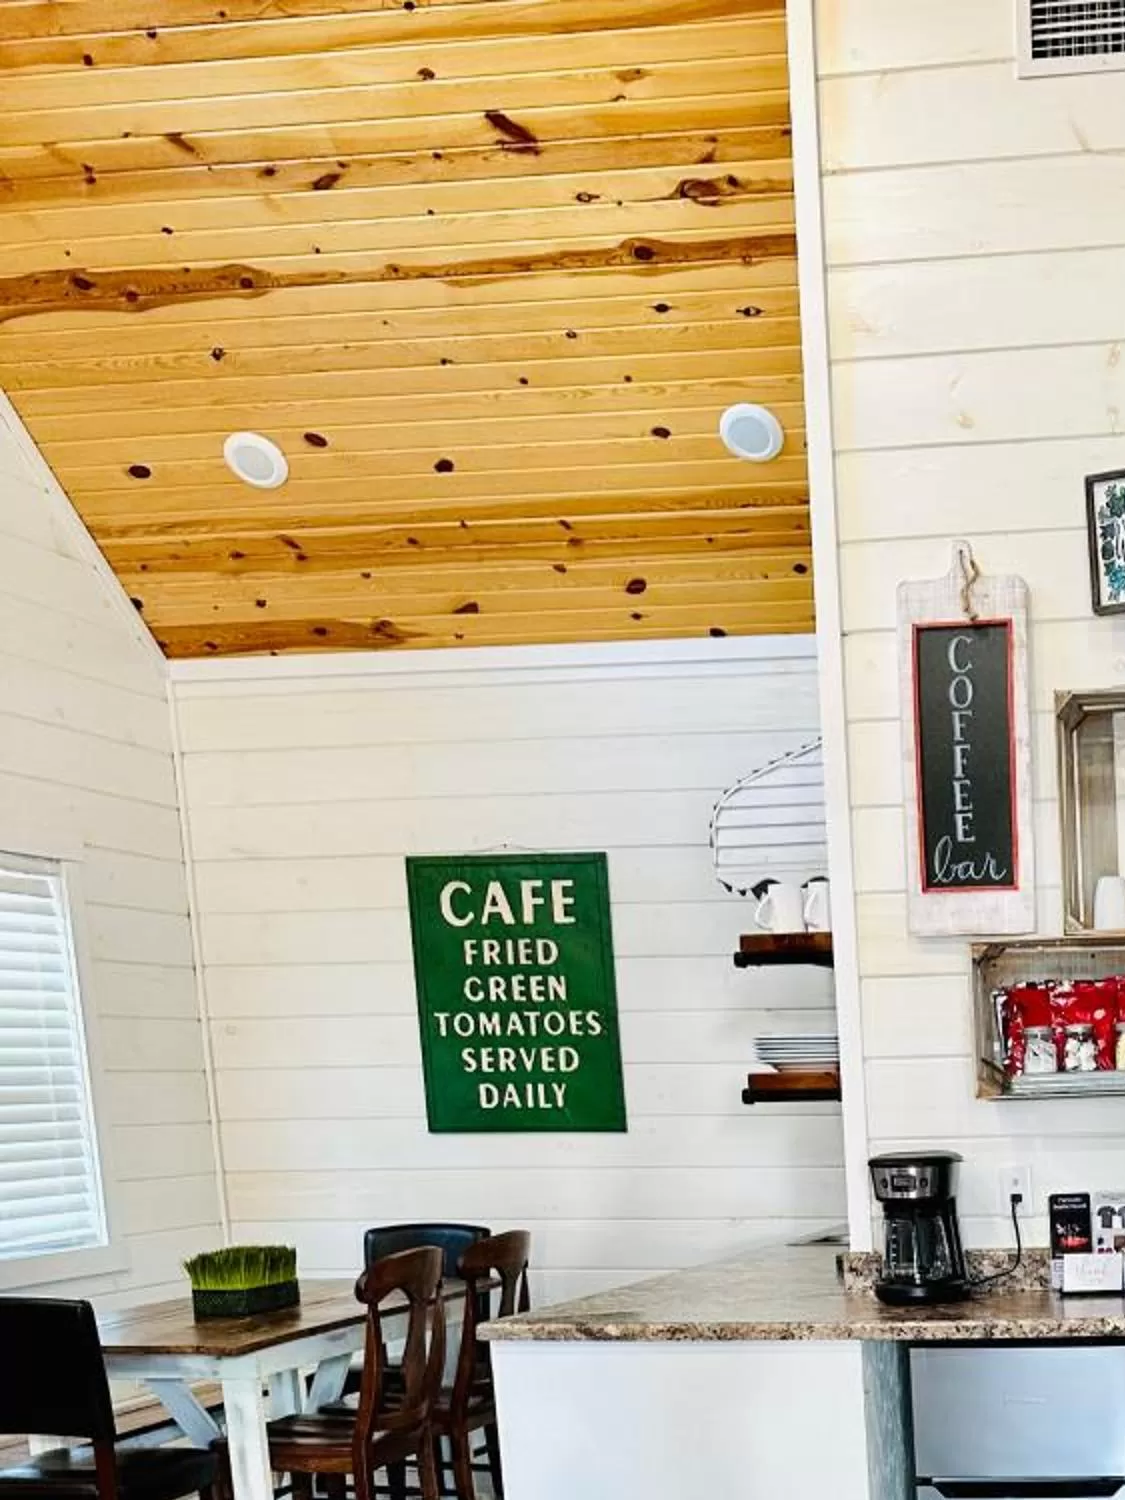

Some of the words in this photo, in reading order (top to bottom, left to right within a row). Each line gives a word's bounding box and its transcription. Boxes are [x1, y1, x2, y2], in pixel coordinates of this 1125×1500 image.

[948, 635, 976, 843] COFFEE
[931, 835, 1007, 883] bar
[439, 879, 577, 928] CAFE
[463, 938, 559, 966] FRIED
[463, 974, 567, 1002] GREEN
[433, 1010, 602, 1037] TOMATOES
[461, 1046, 580, 1073] SERVED
[478, 1083, 567, 1109] DAILY
